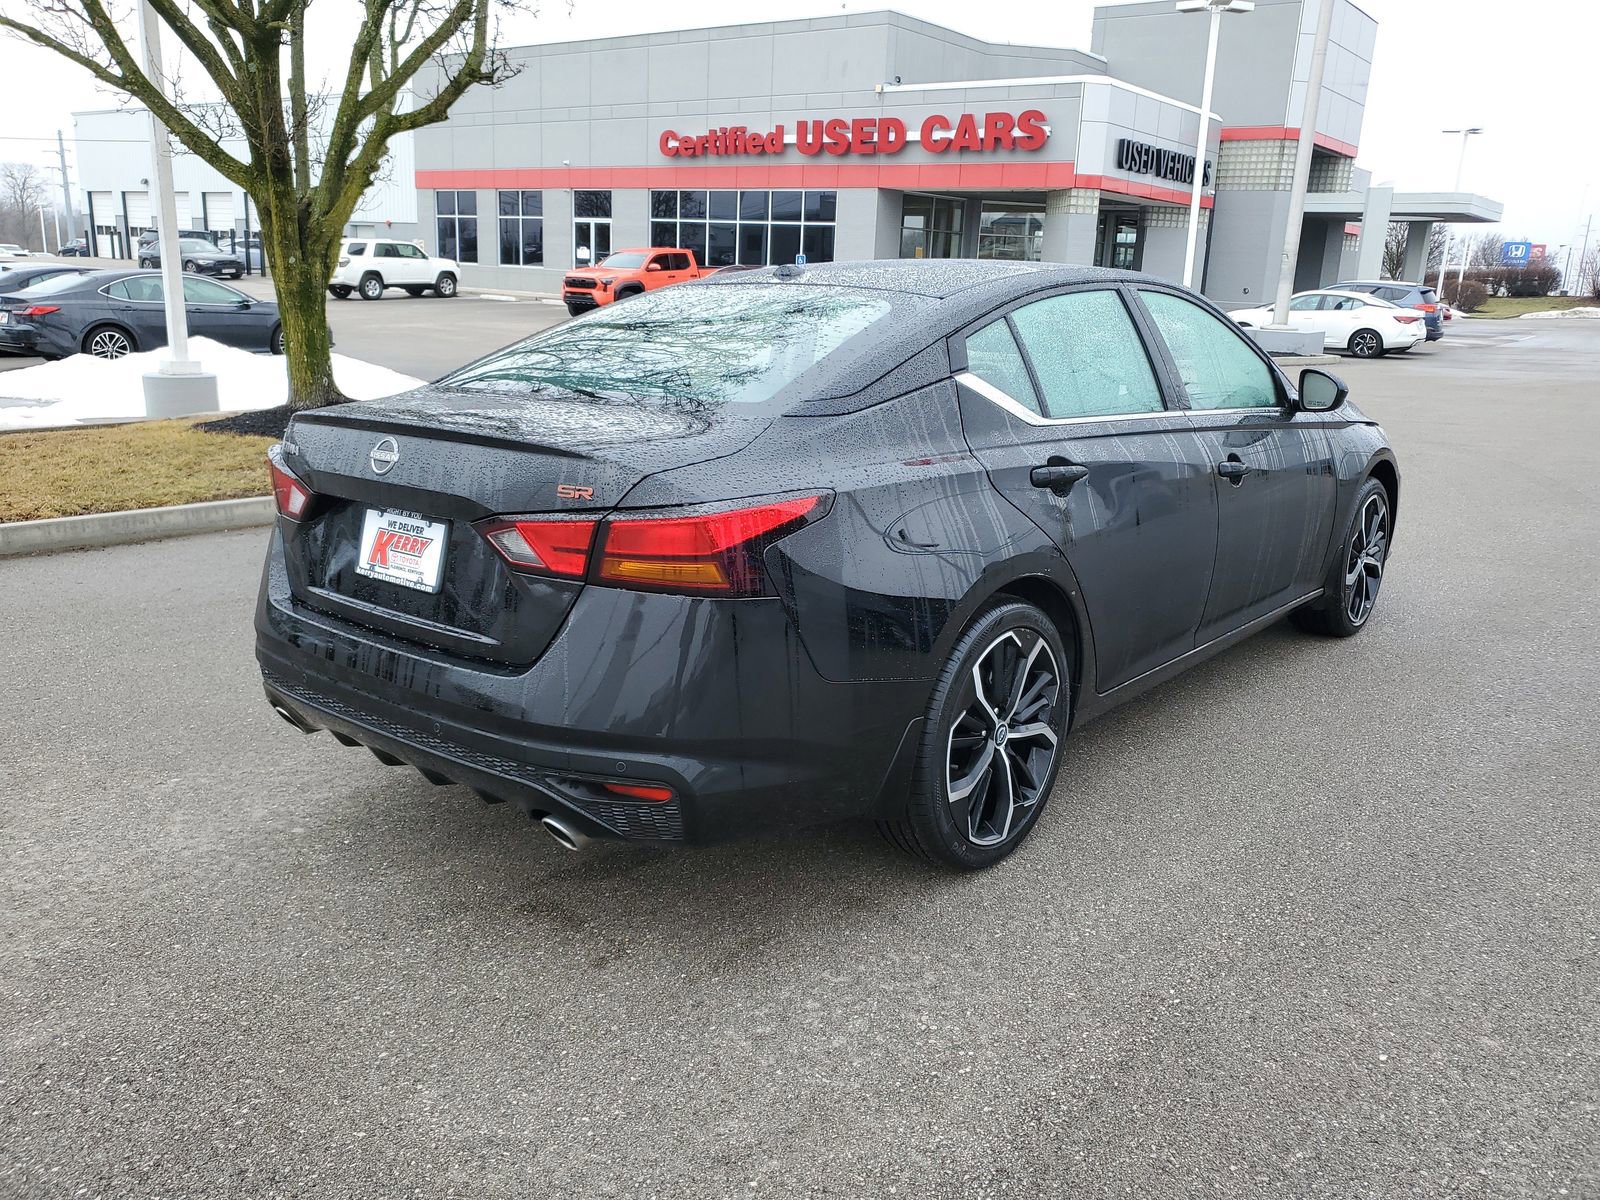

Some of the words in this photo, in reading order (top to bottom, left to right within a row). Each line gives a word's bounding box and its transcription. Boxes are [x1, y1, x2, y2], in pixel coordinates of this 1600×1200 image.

[659, 124, 785, 157] Certified
[796, 117, 907, 156] USED
[920, 109, 1051, 153] CARS
[1118, 138, 1157, 177] USED
[1158, 148, 1212, 187] VEHICS
[557, 484, 594, 501] SR
[402, 509, 411, 517] BY
[411, 511, 423, 520] YOU
[387, 519, 397, 529] WE
[398, 521, 425, 535] DELIVER
[399, 555, 420, 566] TOYOTA
[356, 566, 433, 592] kerryautomotive.com
